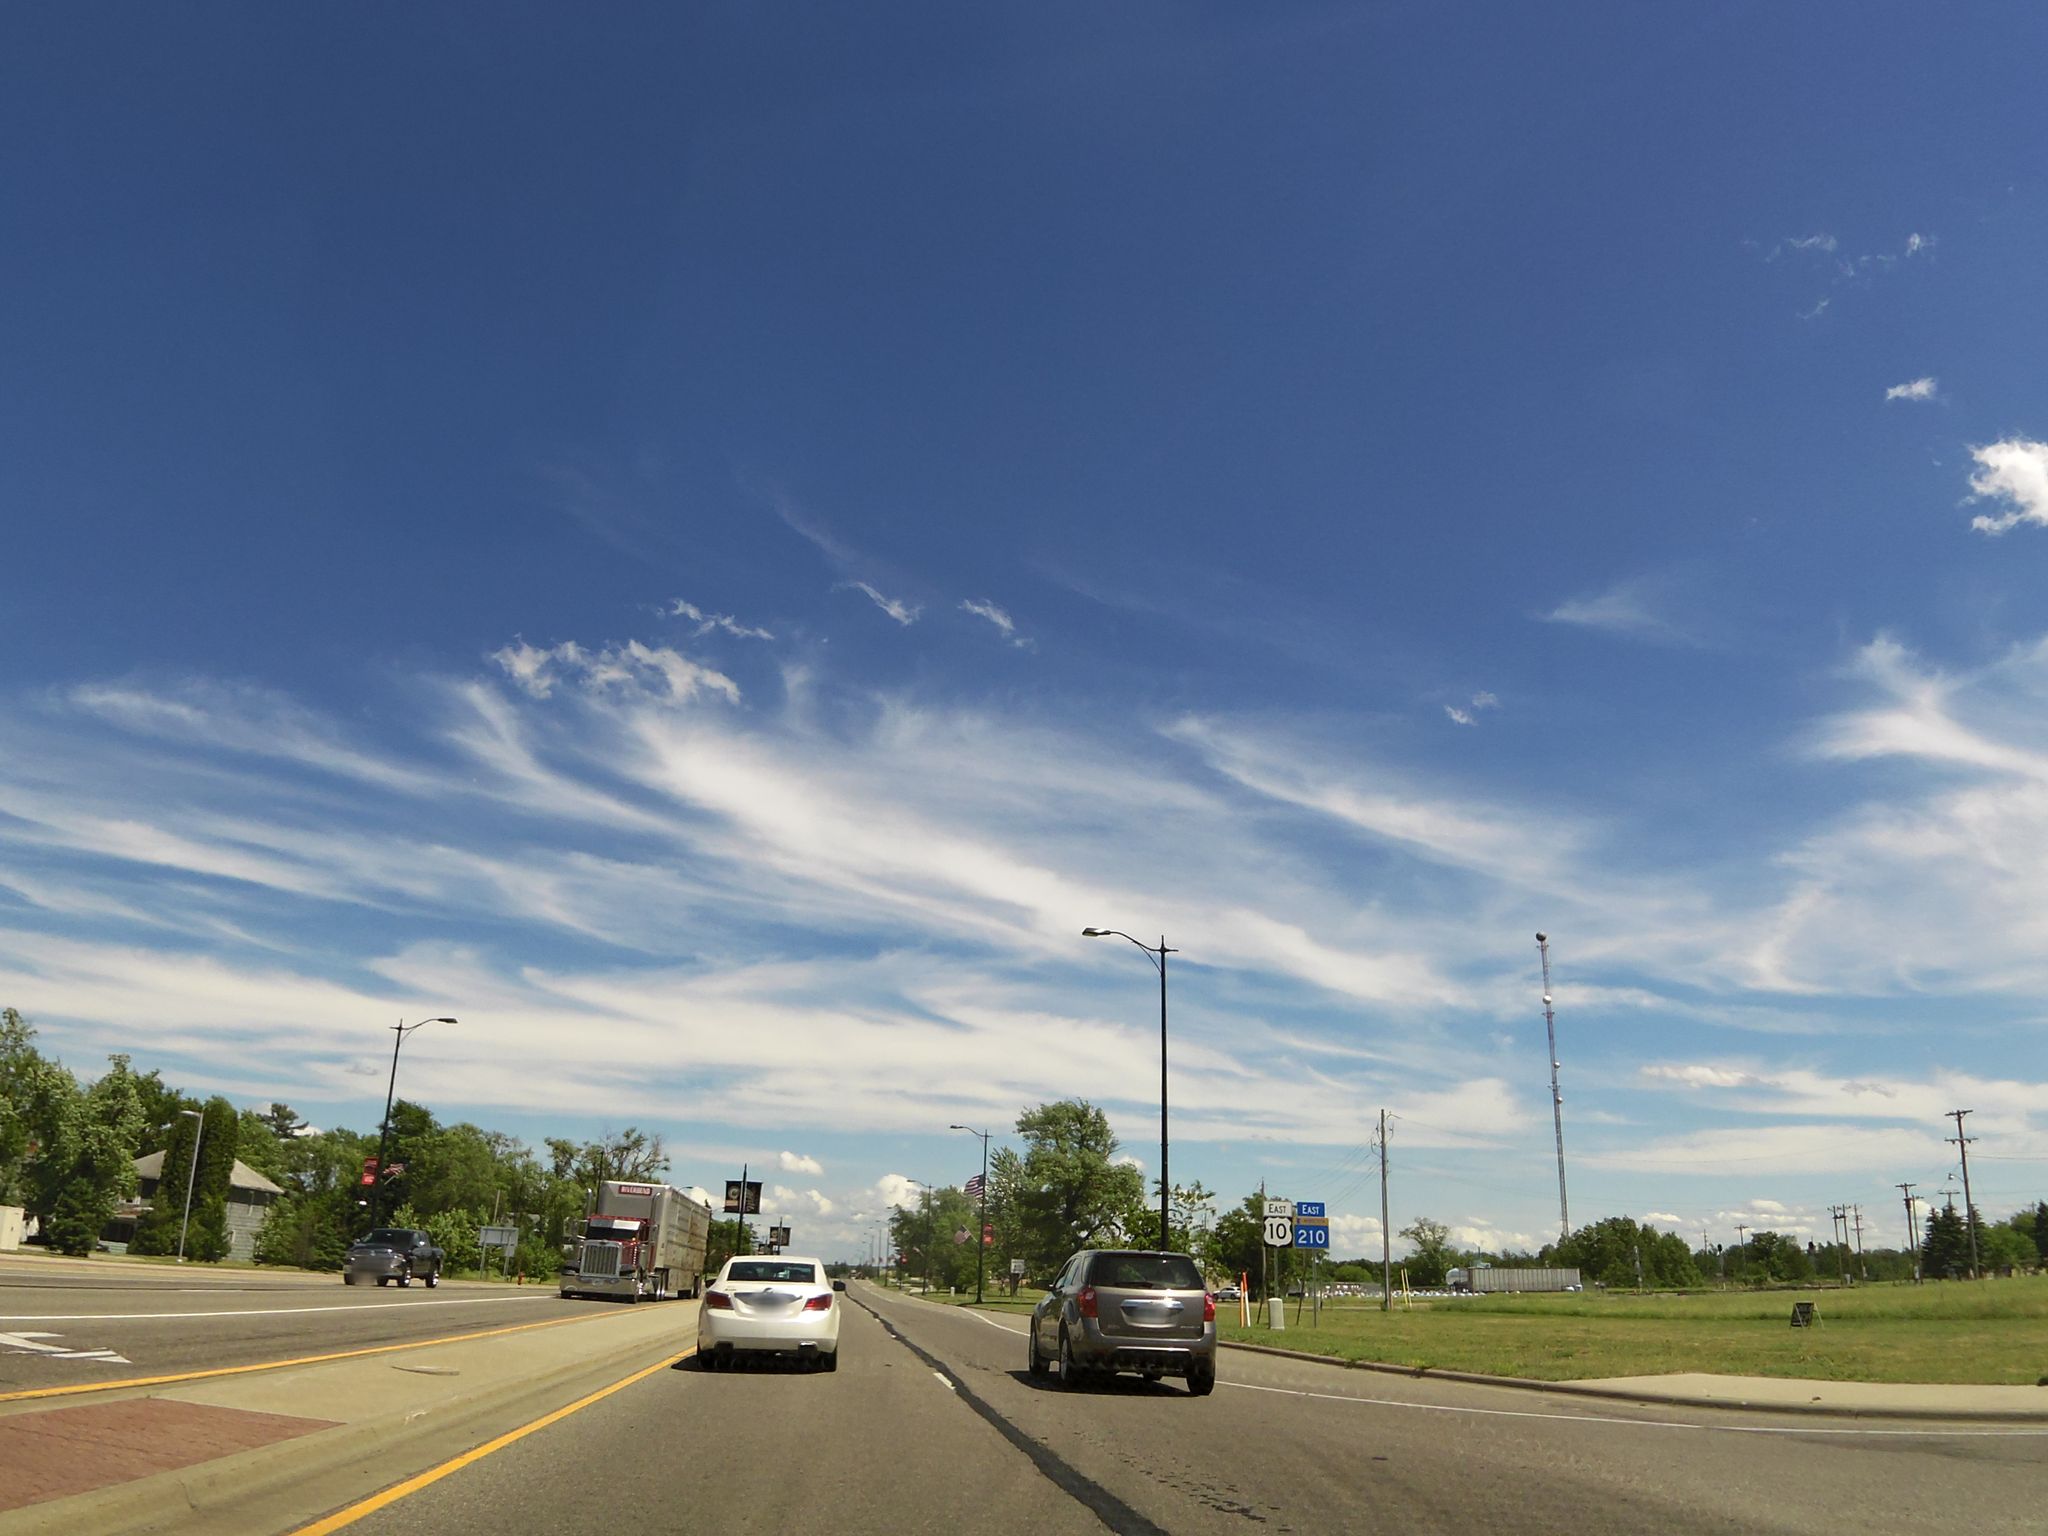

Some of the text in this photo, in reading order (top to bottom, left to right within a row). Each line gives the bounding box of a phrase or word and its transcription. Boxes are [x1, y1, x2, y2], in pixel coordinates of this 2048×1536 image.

[1269, 1204, 1287, 1214] EAST
[1302, 1205, 1319, 1215] EAST
[1269, 1223, 1287, 1239] 10
[1298, 1230, 1325, 1244] 210
